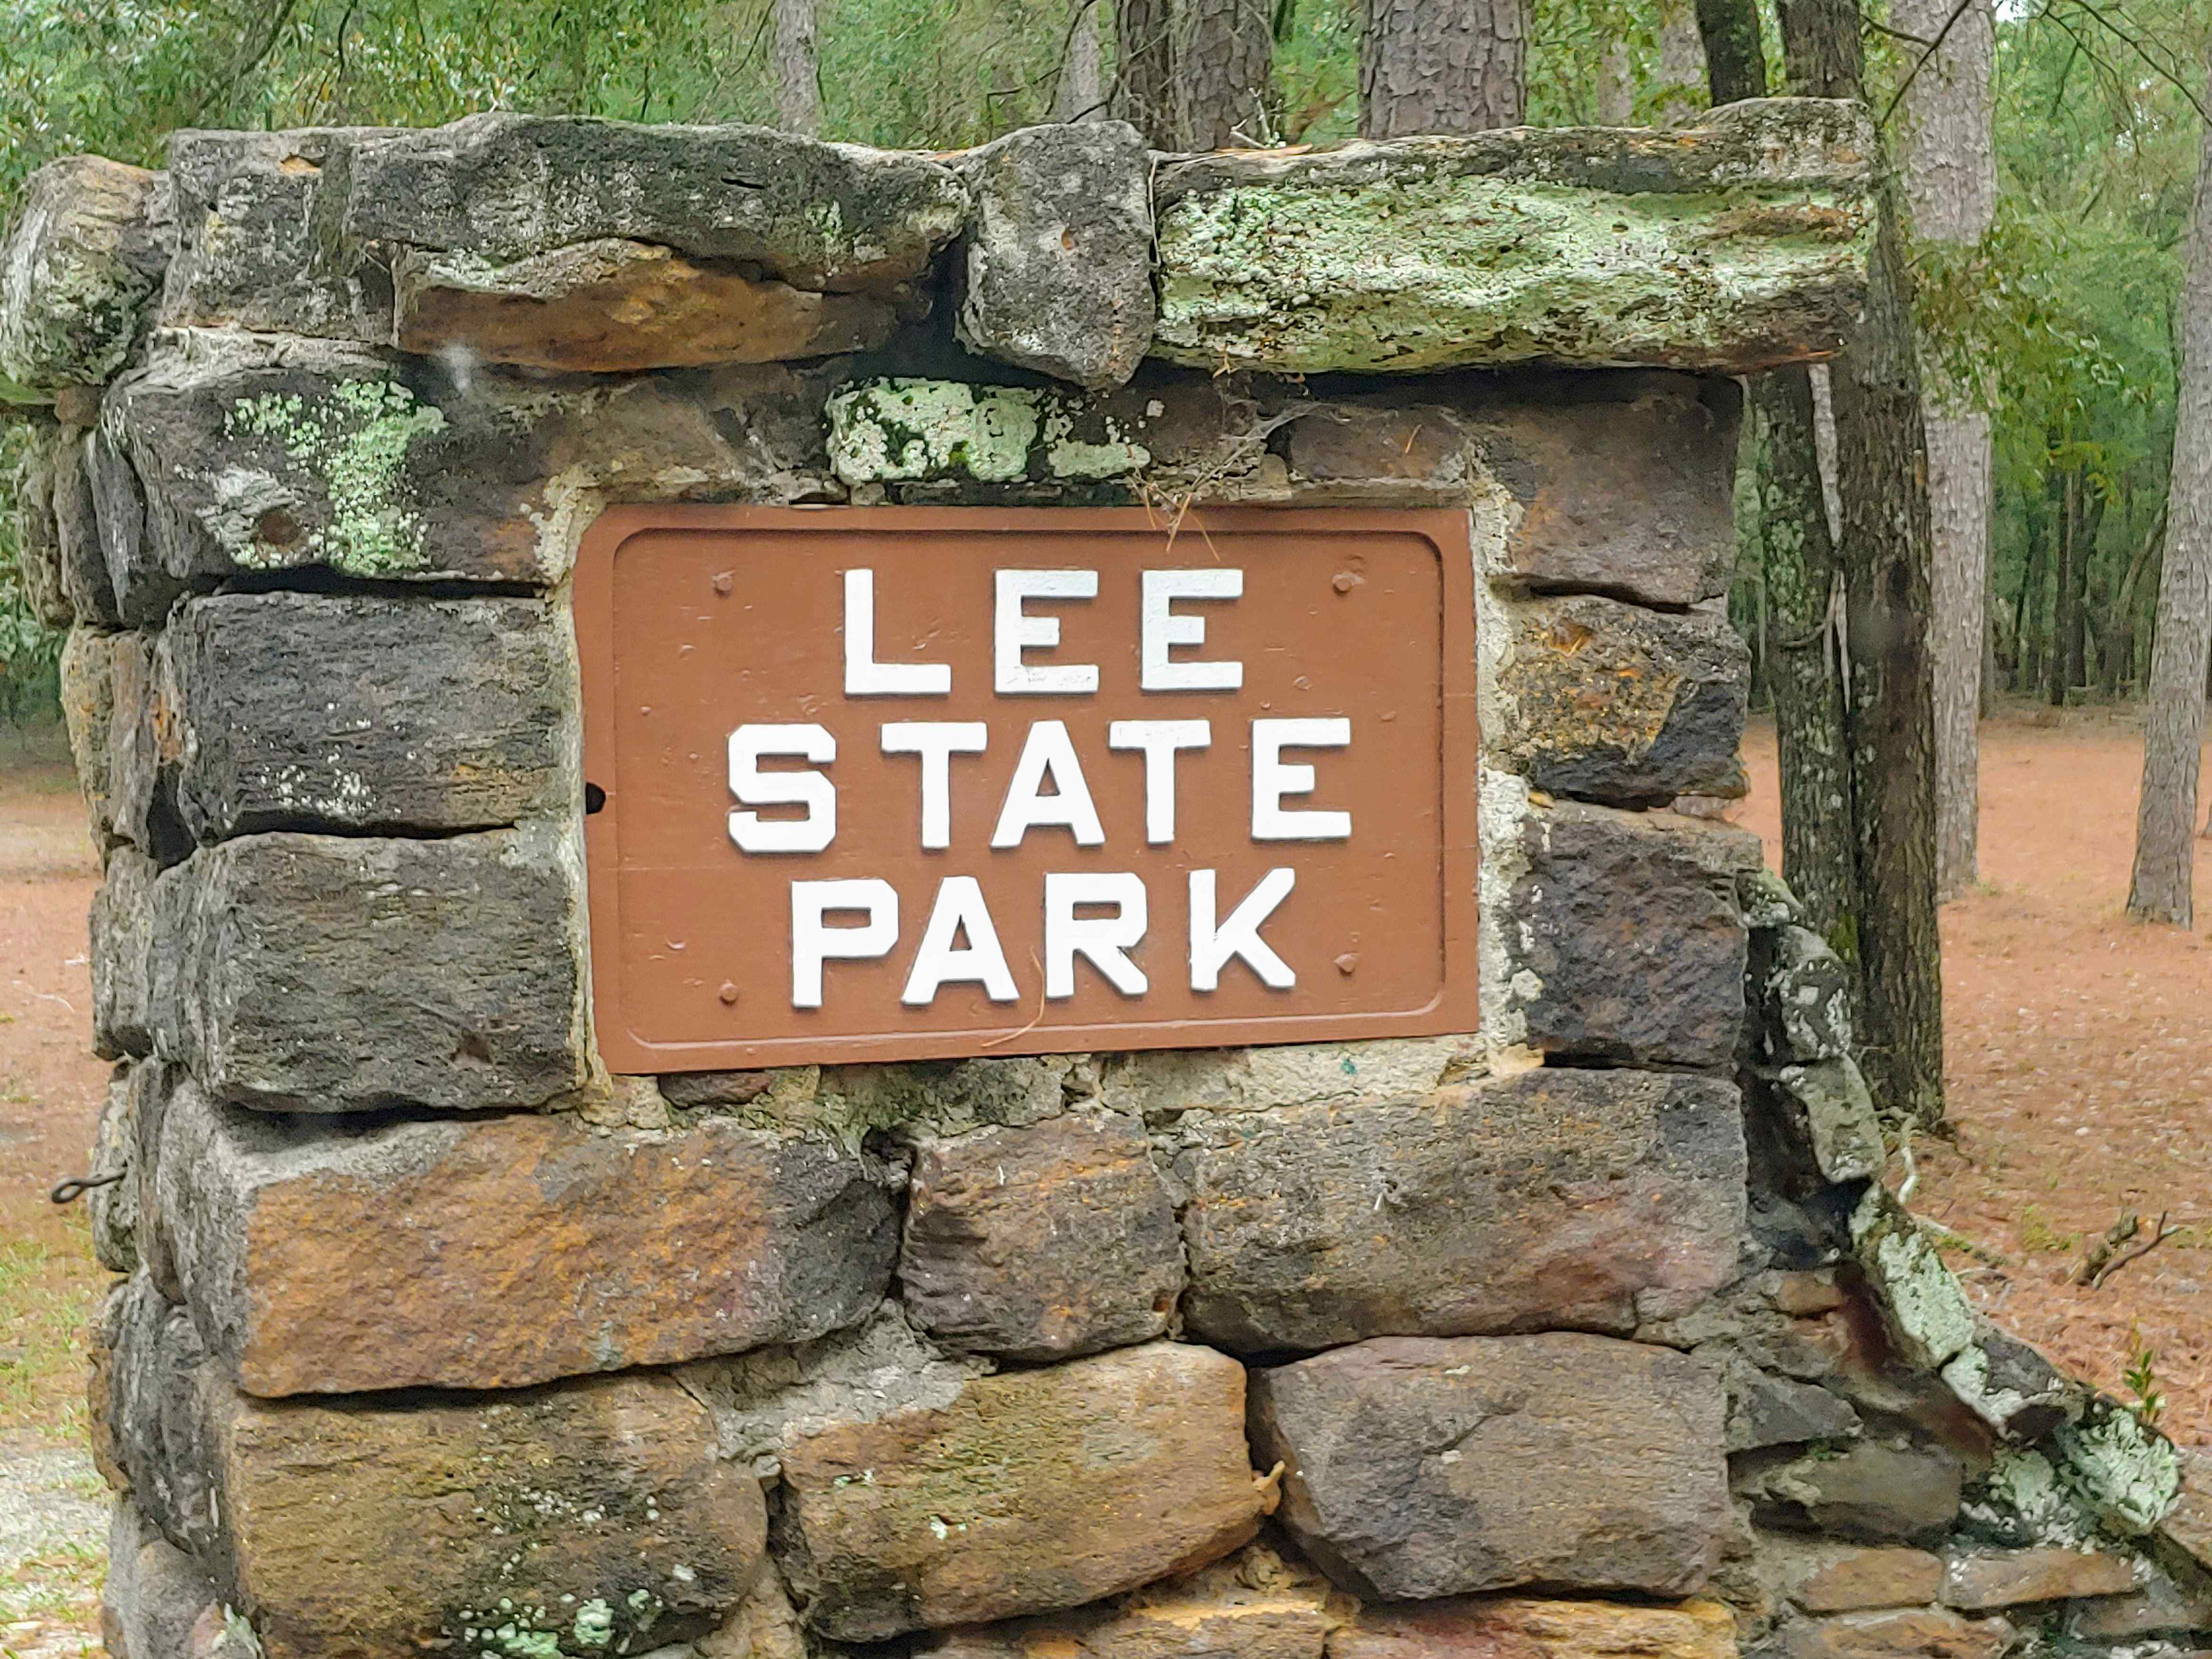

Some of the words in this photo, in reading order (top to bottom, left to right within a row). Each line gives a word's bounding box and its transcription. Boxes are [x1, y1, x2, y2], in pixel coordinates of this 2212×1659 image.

[844, 569, 1244, 695] LEE
[727, 717, 1353, 853] STATE
[790, 868, 1297, 1008] PARK
